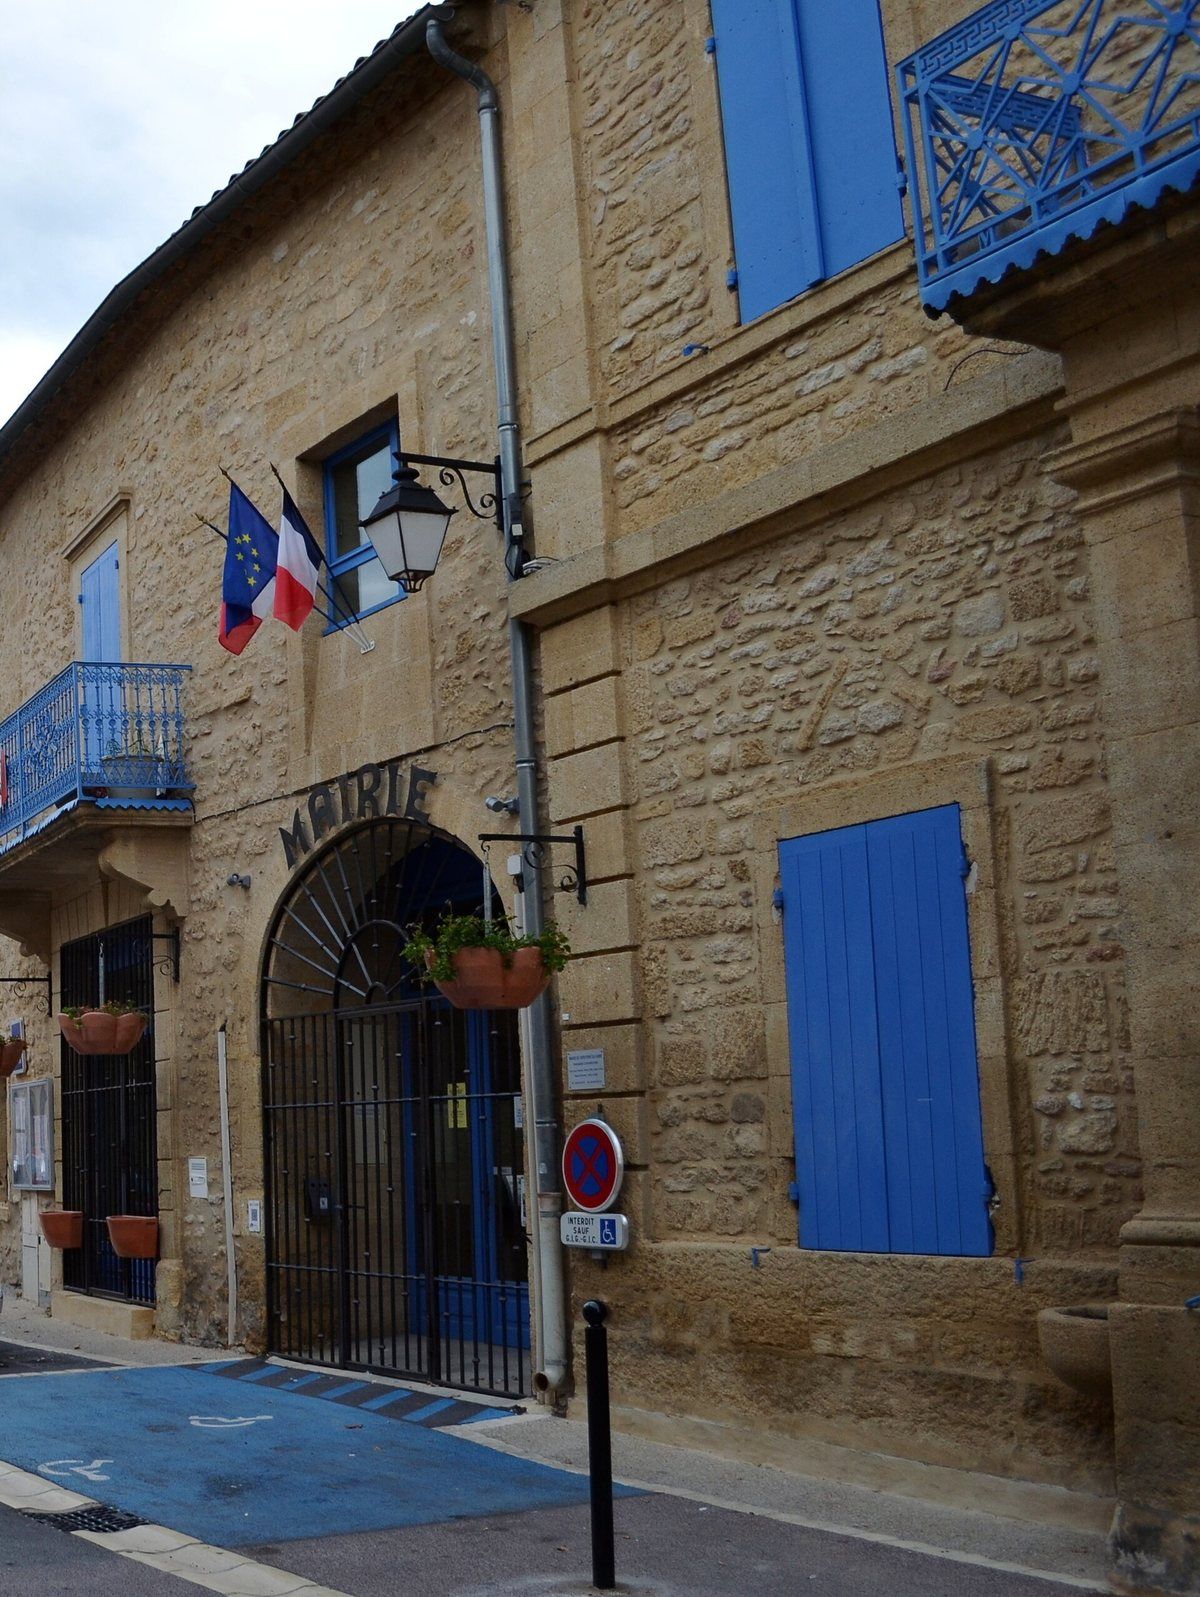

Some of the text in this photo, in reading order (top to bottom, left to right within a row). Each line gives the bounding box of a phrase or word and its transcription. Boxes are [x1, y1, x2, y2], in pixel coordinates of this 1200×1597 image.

[279, 763, 438, 871] MAIRIE
[567, 1217, 595, 1226] INTERDIT
[573, 1227, 590, 1235] SAUF
